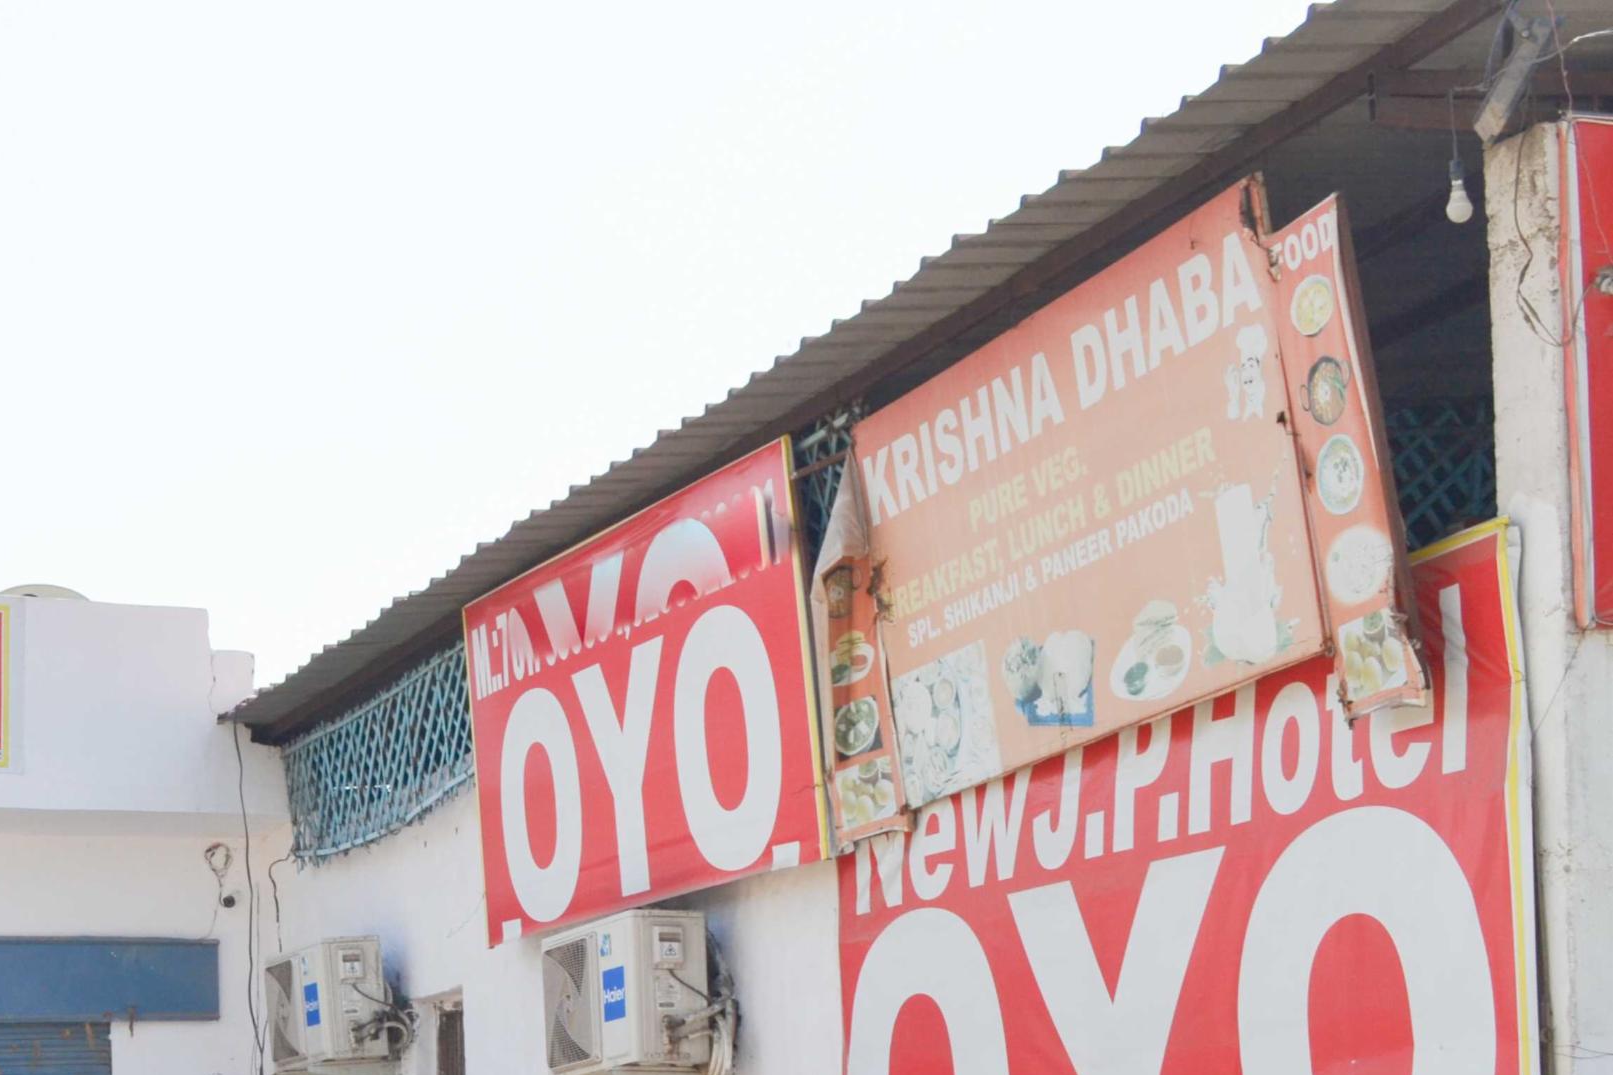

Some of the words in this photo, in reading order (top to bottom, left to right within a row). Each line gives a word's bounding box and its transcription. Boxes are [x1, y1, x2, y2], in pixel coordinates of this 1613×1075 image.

[862, 352, 1065, 527] KRISHNA
[1070, 231, 1263, 411] DHABA
[968, 473, 1028, 534] PURE
[1031, 446, 1088, 497] VEG.
[1007, 499, 1088, 561] LUNCH
[1092, 481, 1112, 519] &
[1116, 426, 1217, 501] DINNER
[907, 610, 941, 649] SPL.
[944, 573, 1021, 632] SHIKANJI
[1024, 564, 1038, 592] &
[1040, 527, 1113, 585] PANEER
[1115, 488, 1194, 551] PAKODA
[500, 603, 782, 923] OYO
[603, 985, 625, 1005] Haier
